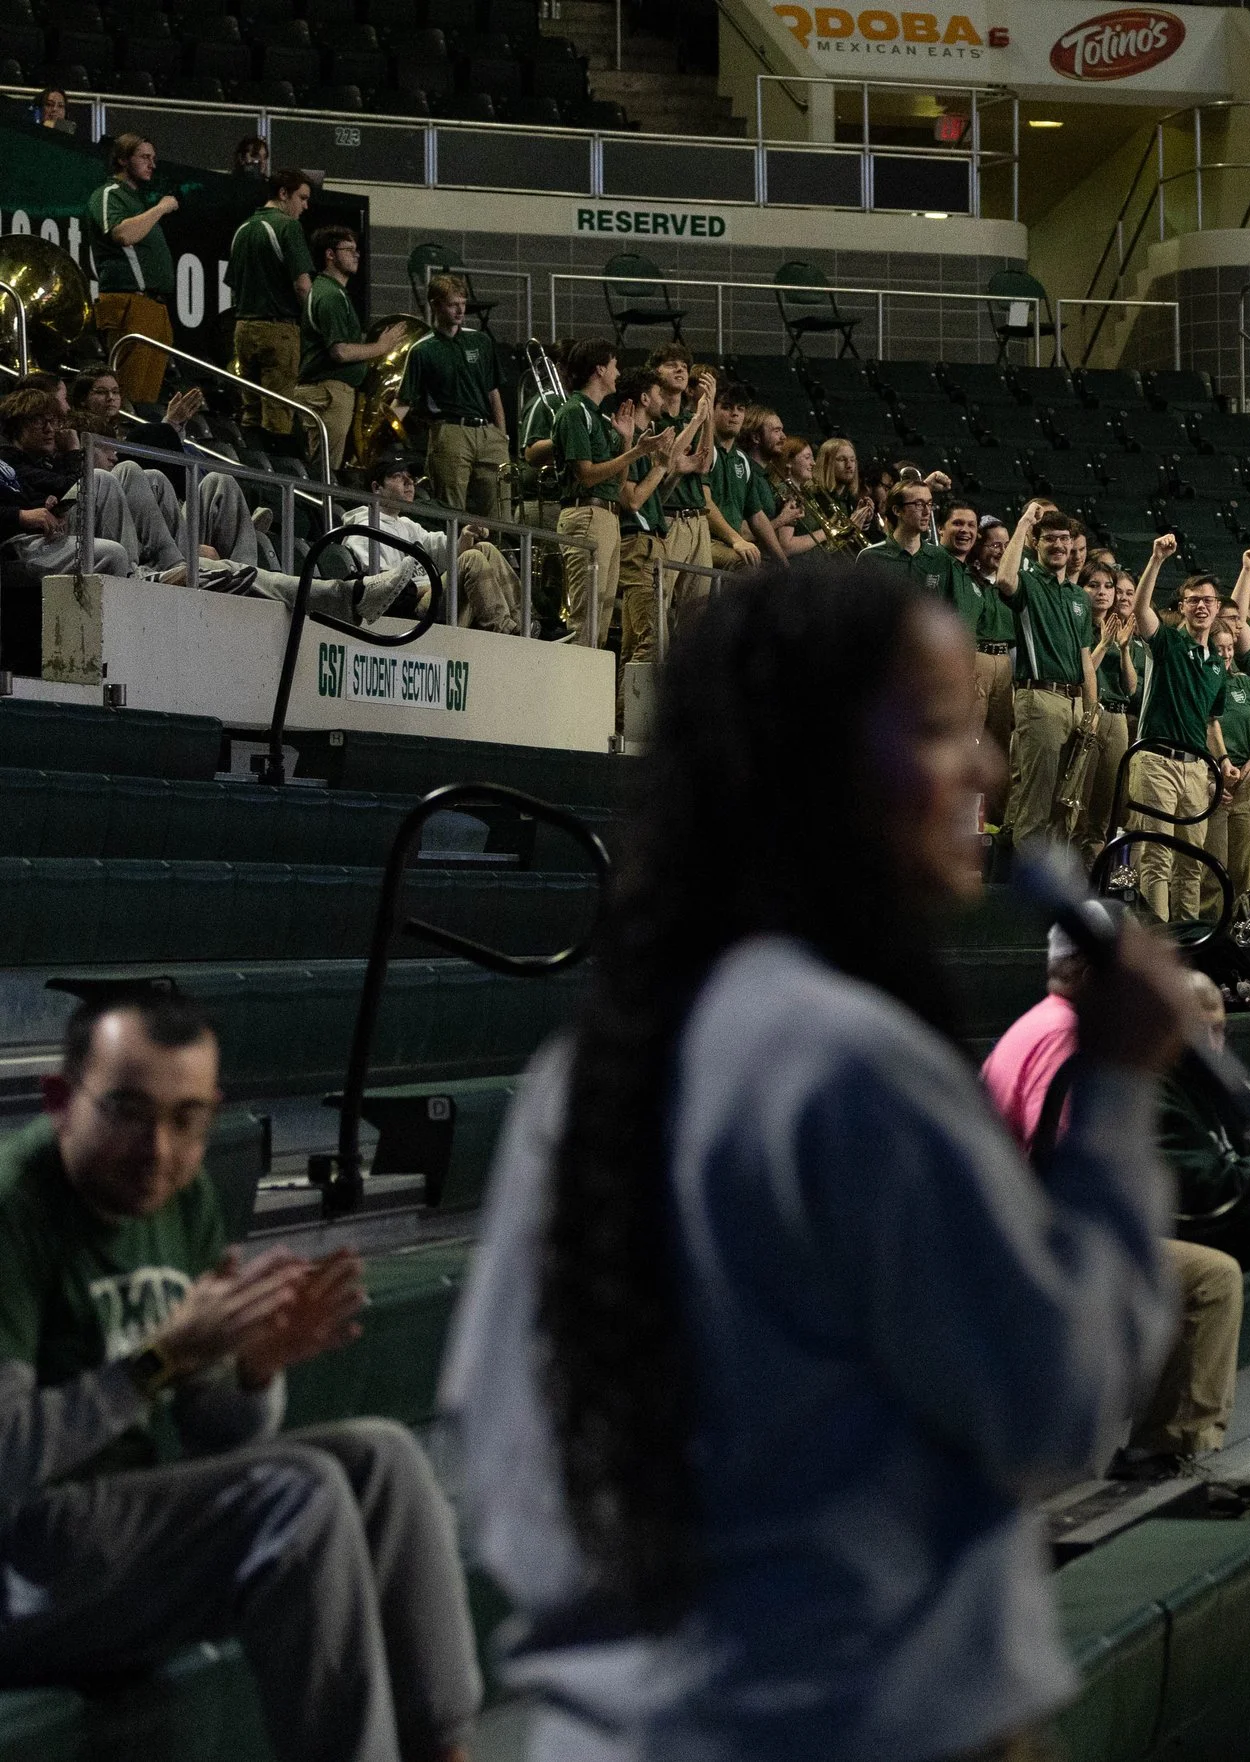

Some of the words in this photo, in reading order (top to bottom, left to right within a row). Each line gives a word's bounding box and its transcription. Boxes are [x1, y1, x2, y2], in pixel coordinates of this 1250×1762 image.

[816, 41, 917, 56] MEXICAN
[928, 47, 981, 59] EATS
[1060, 18, 1169, 76] Totino's
[334, 126, 361, 146] 223
[577, 208, 726, 238] RESERVED
[318, 642, 345, 698] CS7
[353, 653, 397, 699] STUDENT
[401, 659, 441, 703] SECTION
[446, 659, 469, 712] CS7
